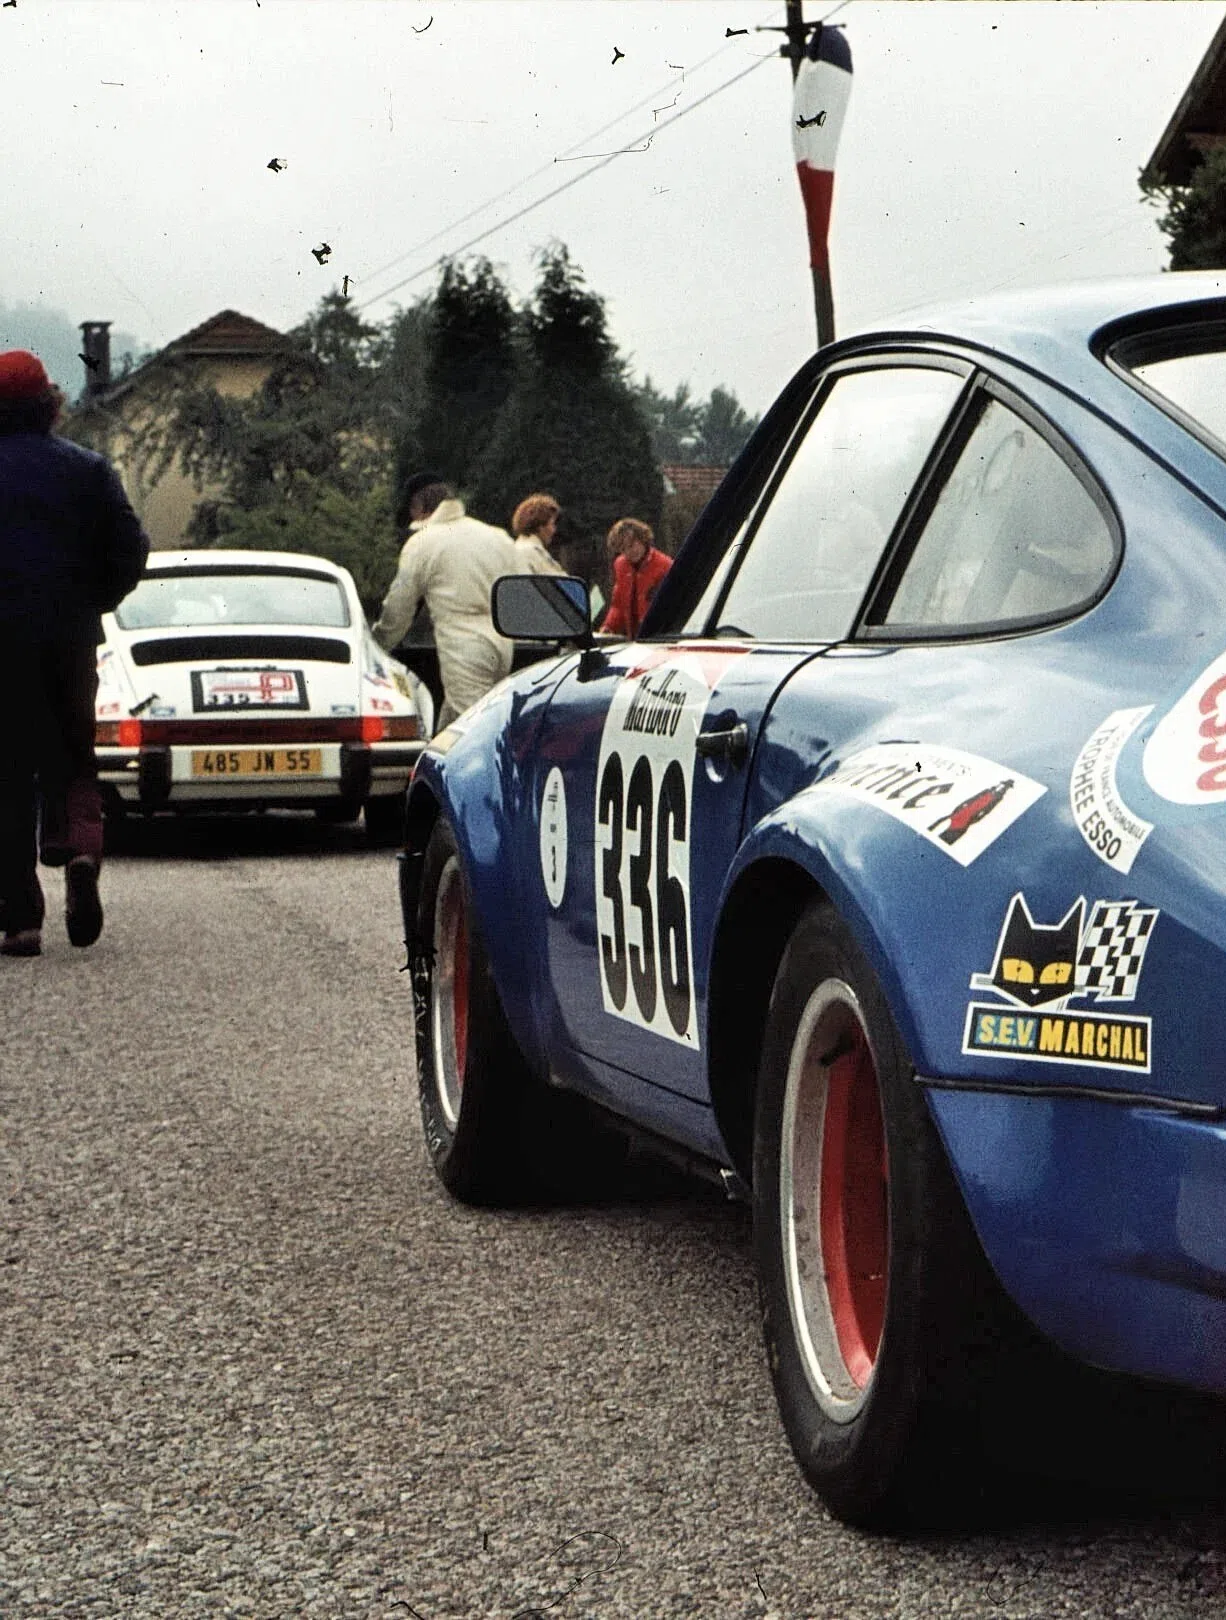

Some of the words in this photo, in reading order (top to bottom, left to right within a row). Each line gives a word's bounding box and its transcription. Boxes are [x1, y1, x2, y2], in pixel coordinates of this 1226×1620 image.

[622, 669, 686, 738] Marlboro
[203, 754, 240, 773] 485
[286, 752, 311, 771] 55
[1081, 810, 1122, 860] ESSO
[599, 751, 691, 1036] 336
[979, 1015, 1034, 1047] S.E.V.
[1040, 1019, 1145, 1062] MARCHAL
